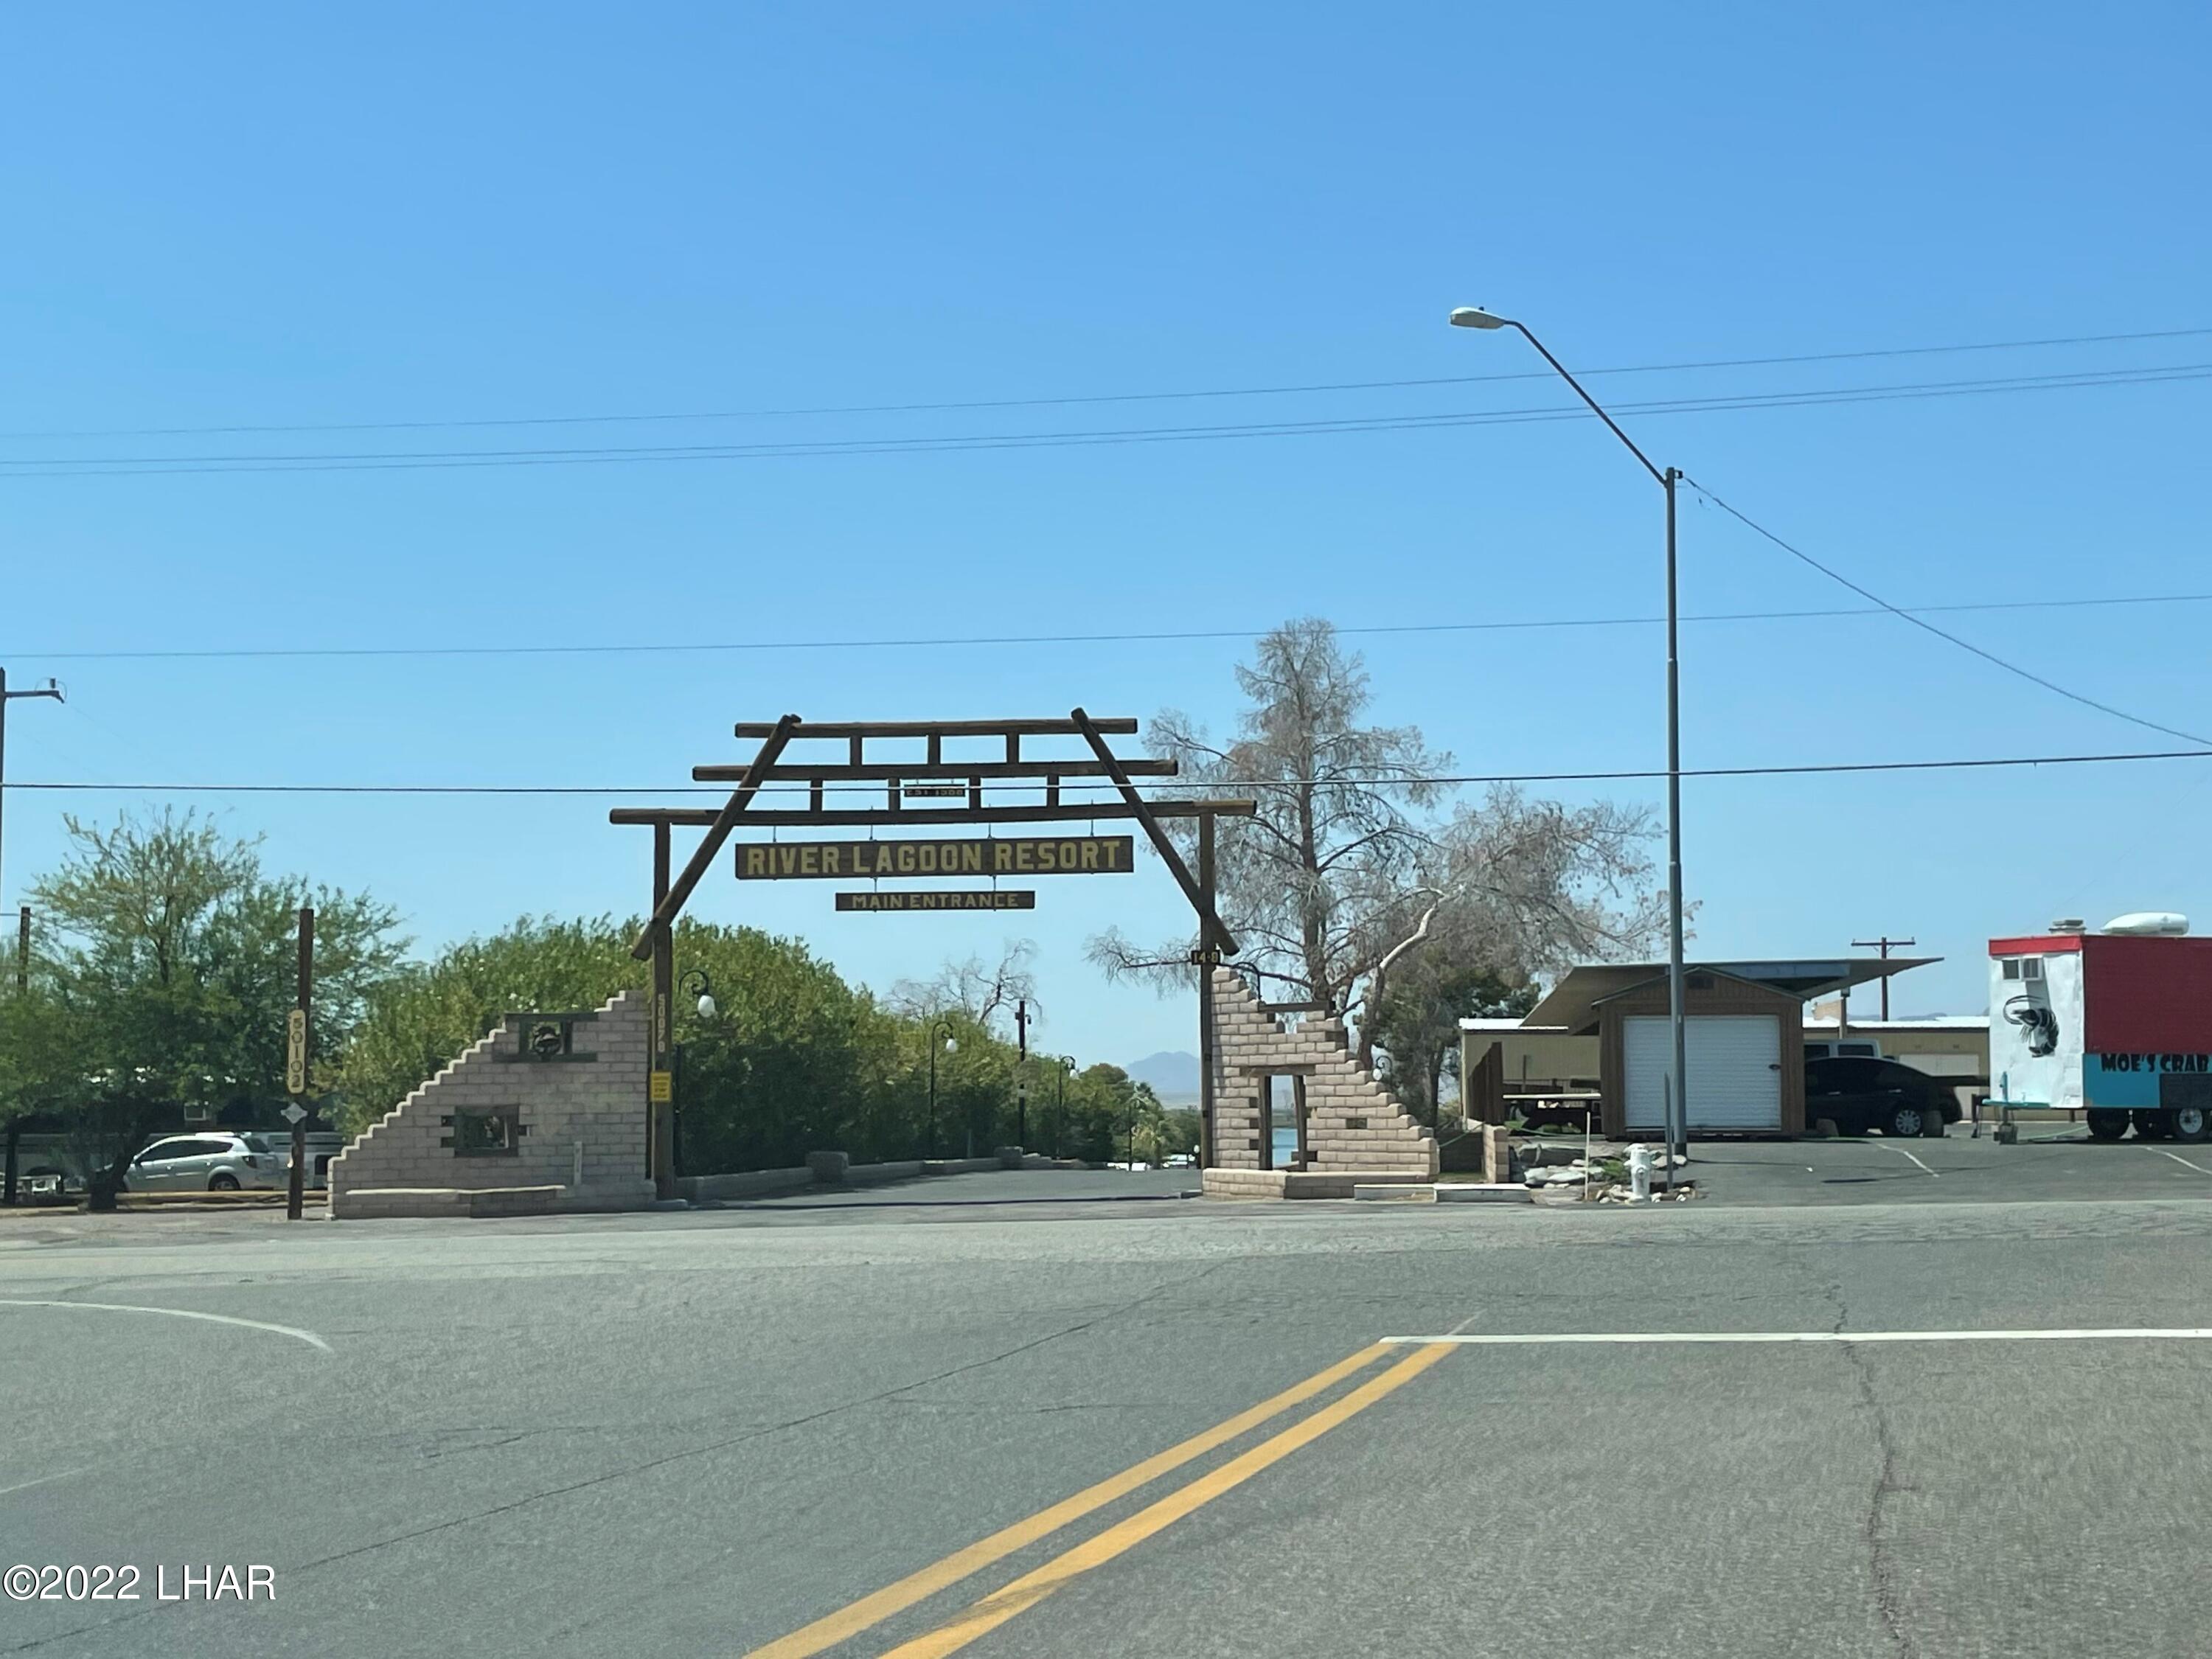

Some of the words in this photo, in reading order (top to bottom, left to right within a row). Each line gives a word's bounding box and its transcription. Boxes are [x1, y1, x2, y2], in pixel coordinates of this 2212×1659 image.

[747, 846, 840, 875] RIVER
[852, 844, 981, 873] LAGOON
[995, 841, 1120, 870] RESORT
[852, 894, 907, 909] MAIN
[910, 893, 1018, 908] ENTRANCE
[291, 1017, 303, 1088] 50102
[2101, 1053, 2156, 1072] MOE'S
